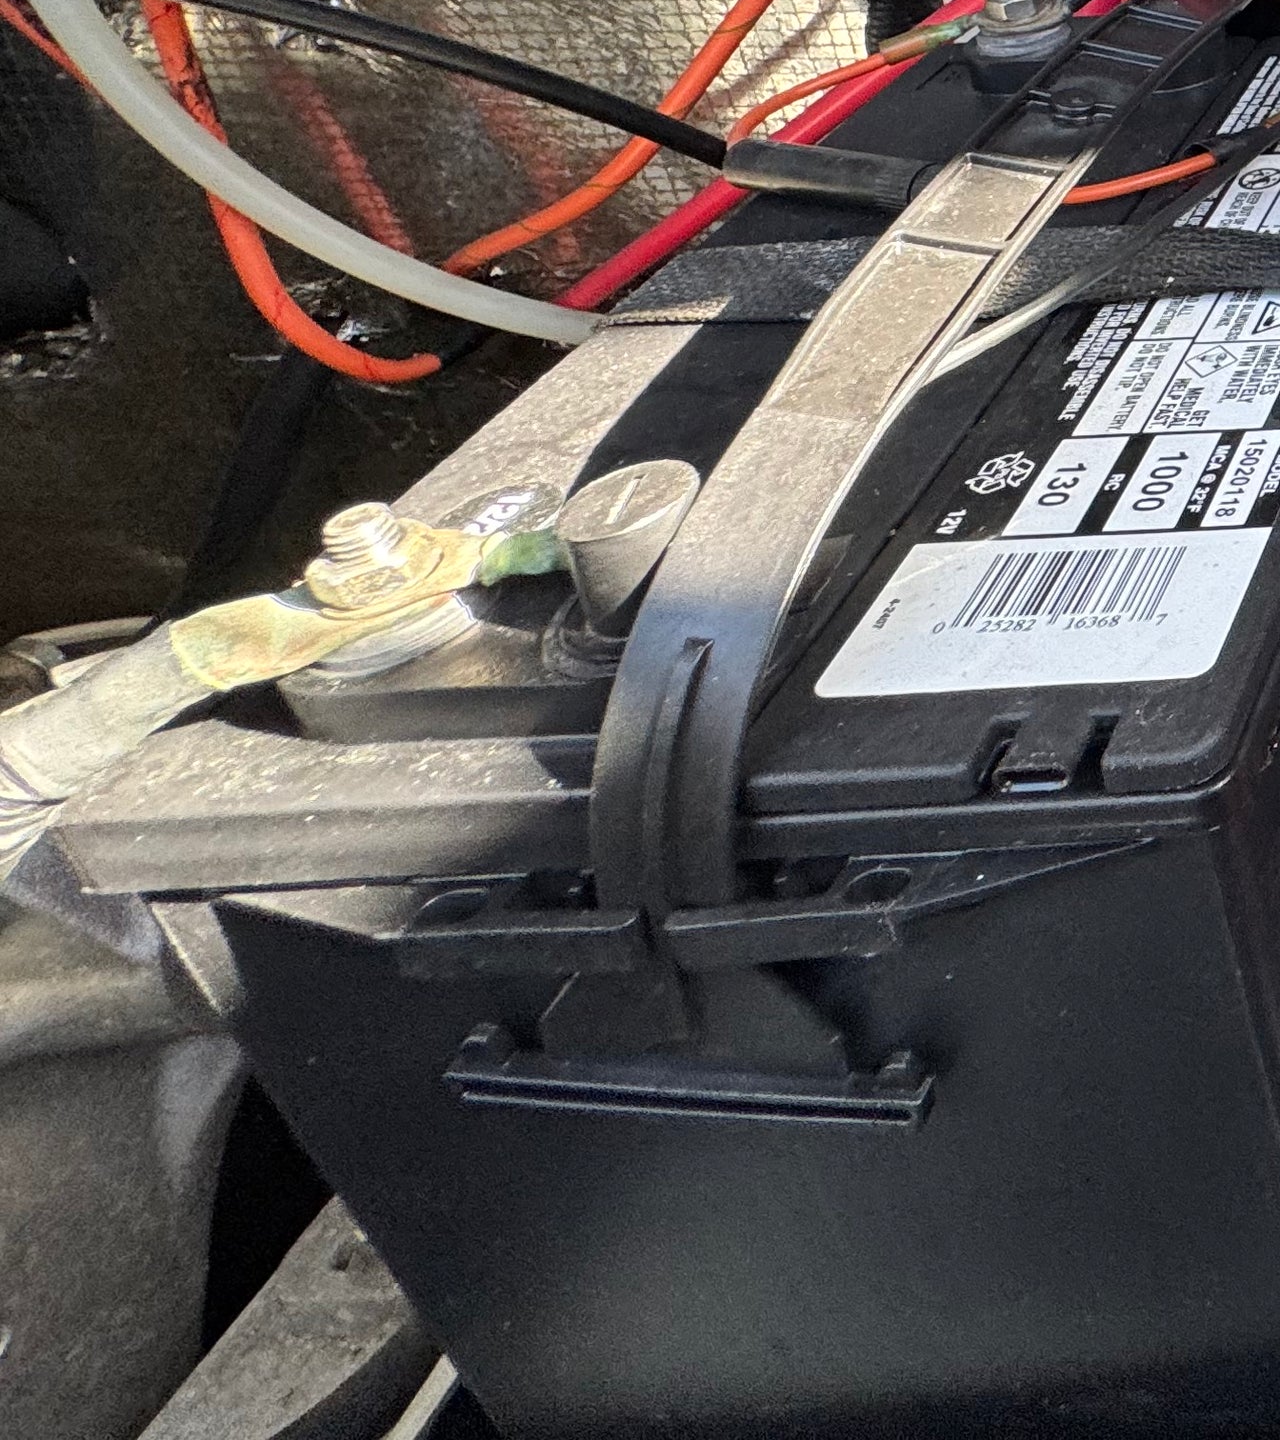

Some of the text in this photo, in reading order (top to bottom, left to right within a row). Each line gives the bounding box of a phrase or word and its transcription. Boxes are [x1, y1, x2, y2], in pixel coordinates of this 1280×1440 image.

[1125, 343, 1157, 373] DO NOT
[1129, 341, 1173, 393] DO NOT OPEN
[1237, 344, 1262, 367] WITH
[1236, 343, 1279, 403] IMMEDIATELY
[1166, 377, 1192, 400] HELP
[1166, 387, 1205, 428] MEDICAL
[1186, 409, 1210, 427] GET
[1205, 444, 1231, 471] MCA
[1037, 462, 1087, 506] 130
[1103, 473, 1126, 491] RC
[1131, 450, 1188, 512] 1000
[1199, 473, 1217, 484] @
[1214, 438, 1267, 517] 15020118
[935, 508, 967, 534] 12V
[932, 614, 1168, 634] 0 25282 16368 7
